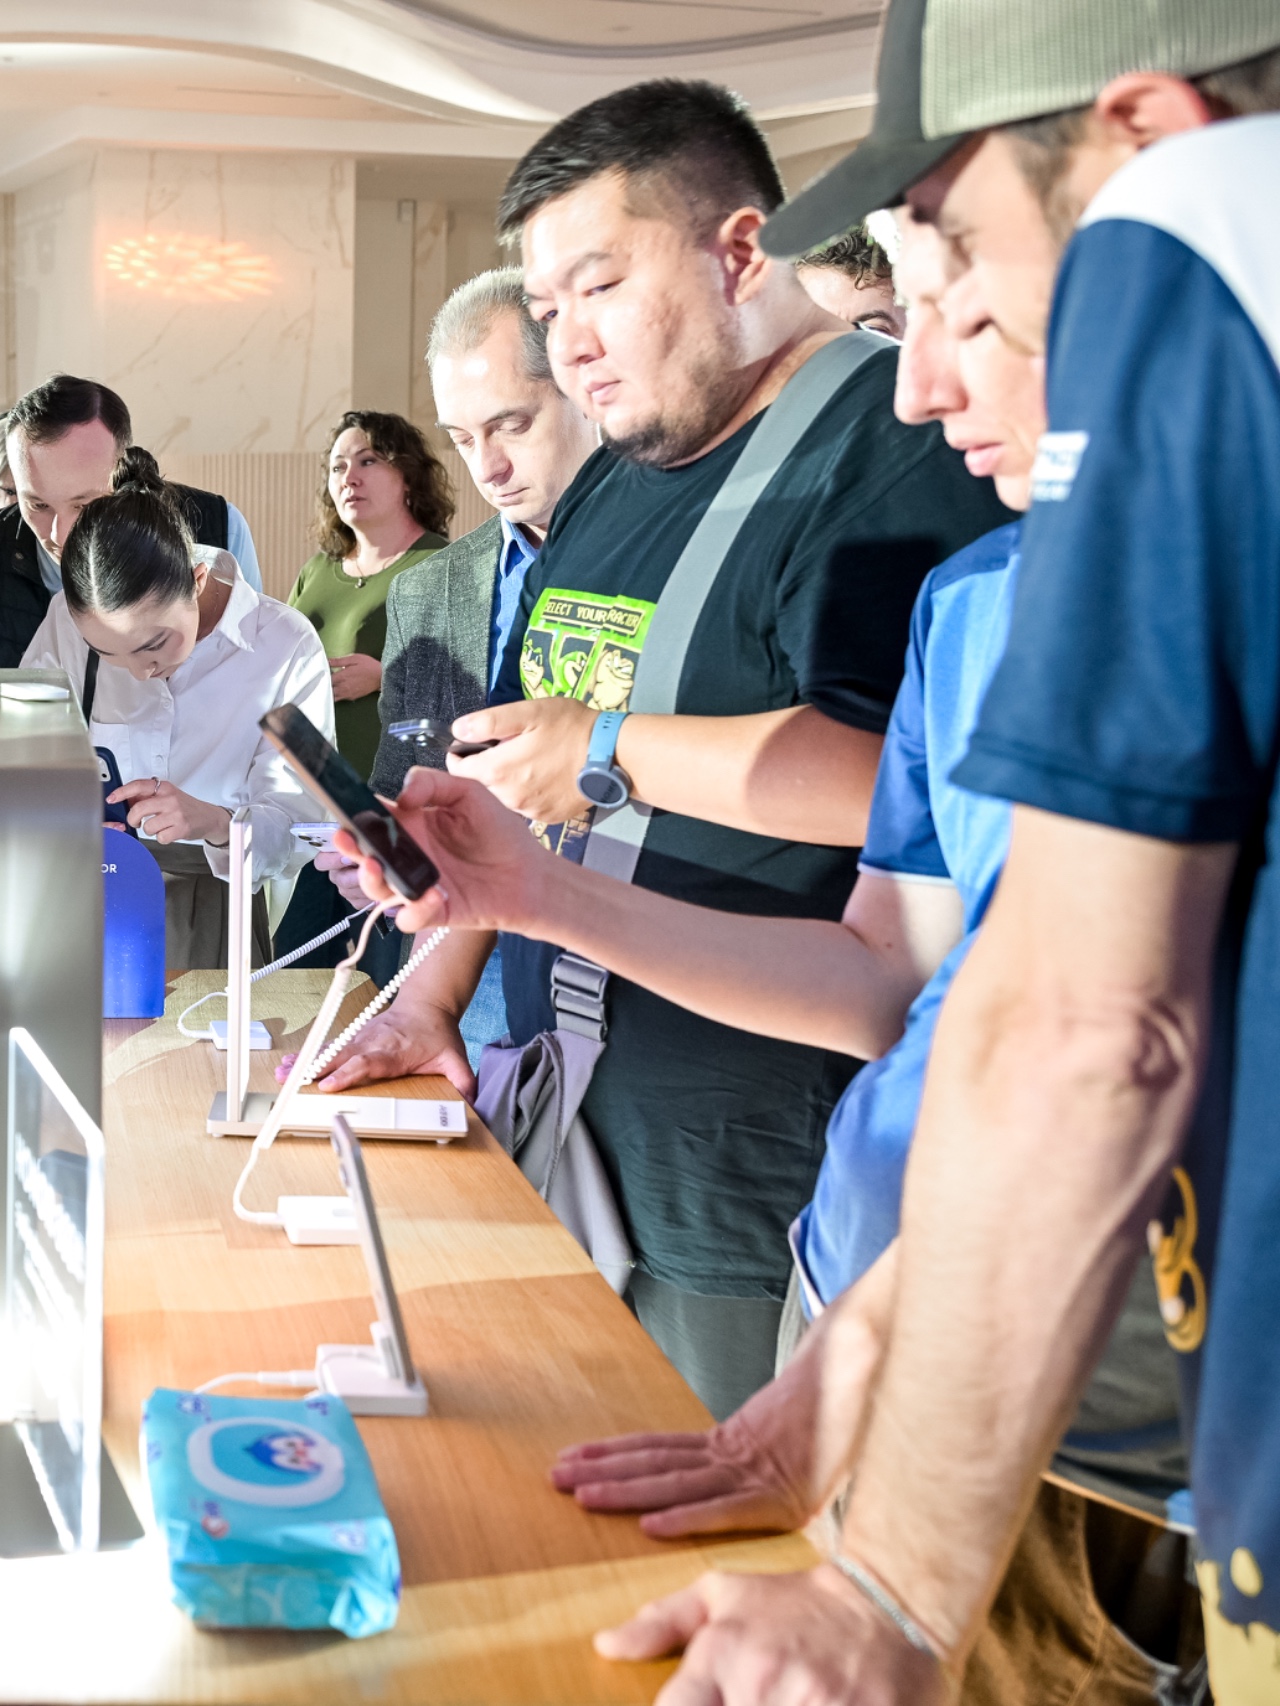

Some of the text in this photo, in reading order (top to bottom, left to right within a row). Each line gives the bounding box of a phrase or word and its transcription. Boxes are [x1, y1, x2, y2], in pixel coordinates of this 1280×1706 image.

[545, 601, 641, 628] SELECT YOUR RACER
[101, 863, 118, 874] OR
